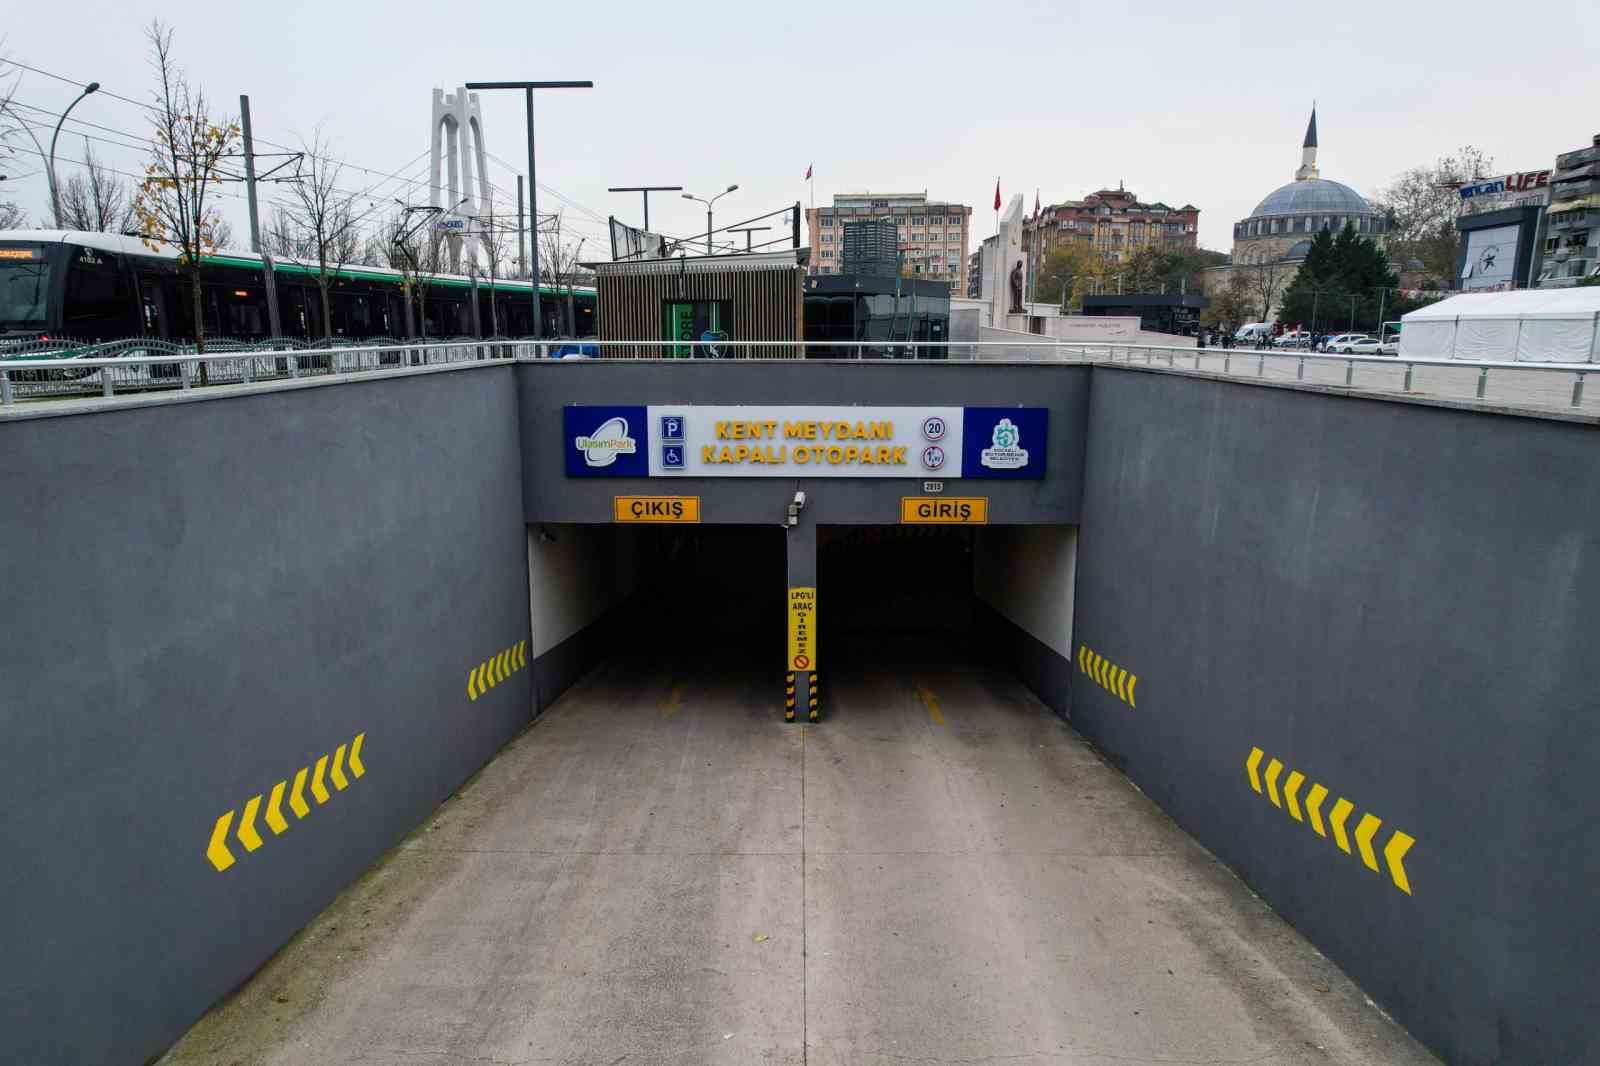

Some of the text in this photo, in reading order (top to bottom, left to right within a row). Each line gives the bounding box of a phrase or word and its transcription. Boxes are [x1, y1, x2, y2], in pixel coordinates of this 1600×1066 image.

[1505, 170, 1550, 192] LIFE
[668, 422, 678, 437] P
[715, 420, 894, 440] KENT MEYDANI
[928, 422, 941, 434] 20
[703, 444, 907, 464] KAPALI OTOPARK
[631, 501, 683, 519] ÇIKIŞ
[918, 501, 971, 520] GİRİŞ
[792, 602, 813, 611] ARAÇ
